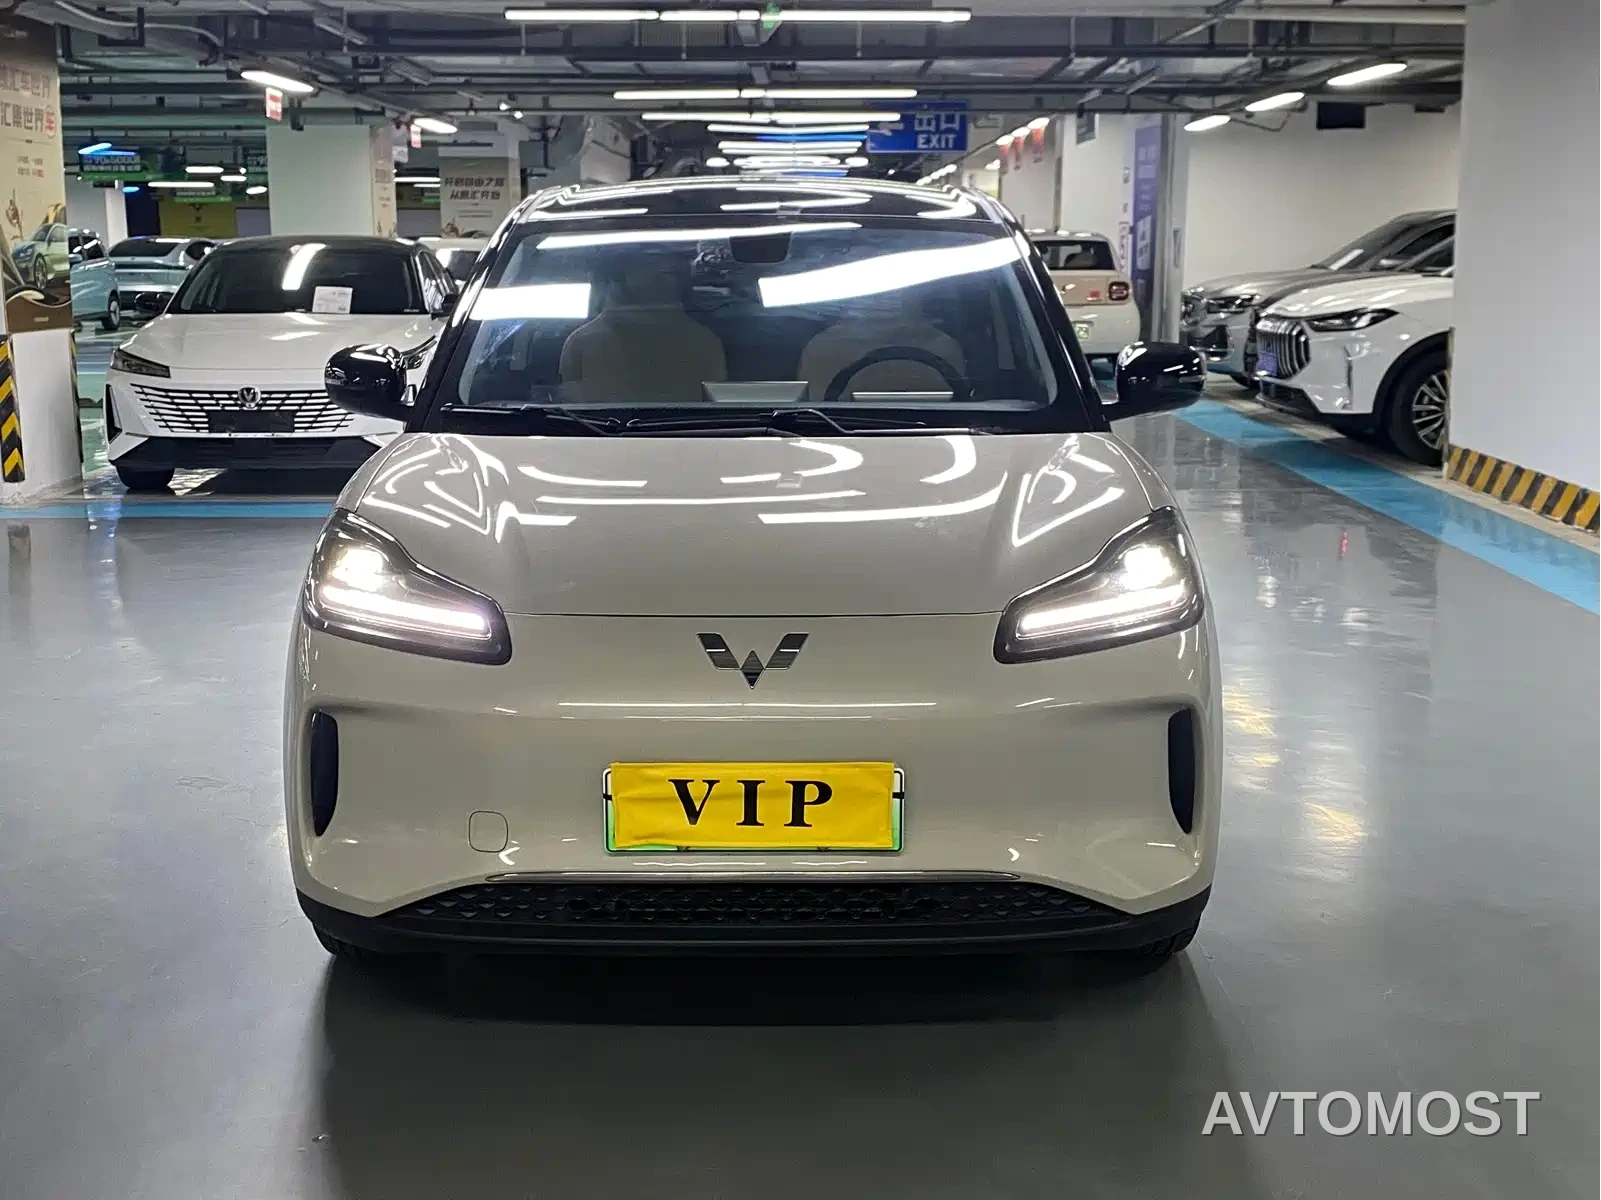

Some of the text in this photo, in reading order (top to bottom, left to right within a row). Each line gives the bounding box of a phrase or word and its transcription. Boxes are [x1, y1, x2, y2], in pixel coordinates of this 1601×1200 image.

[914, 105, 960, 132] 出口
[917, 134, 957, 149] EXIT
[668, 778, 833, 828] VIP
